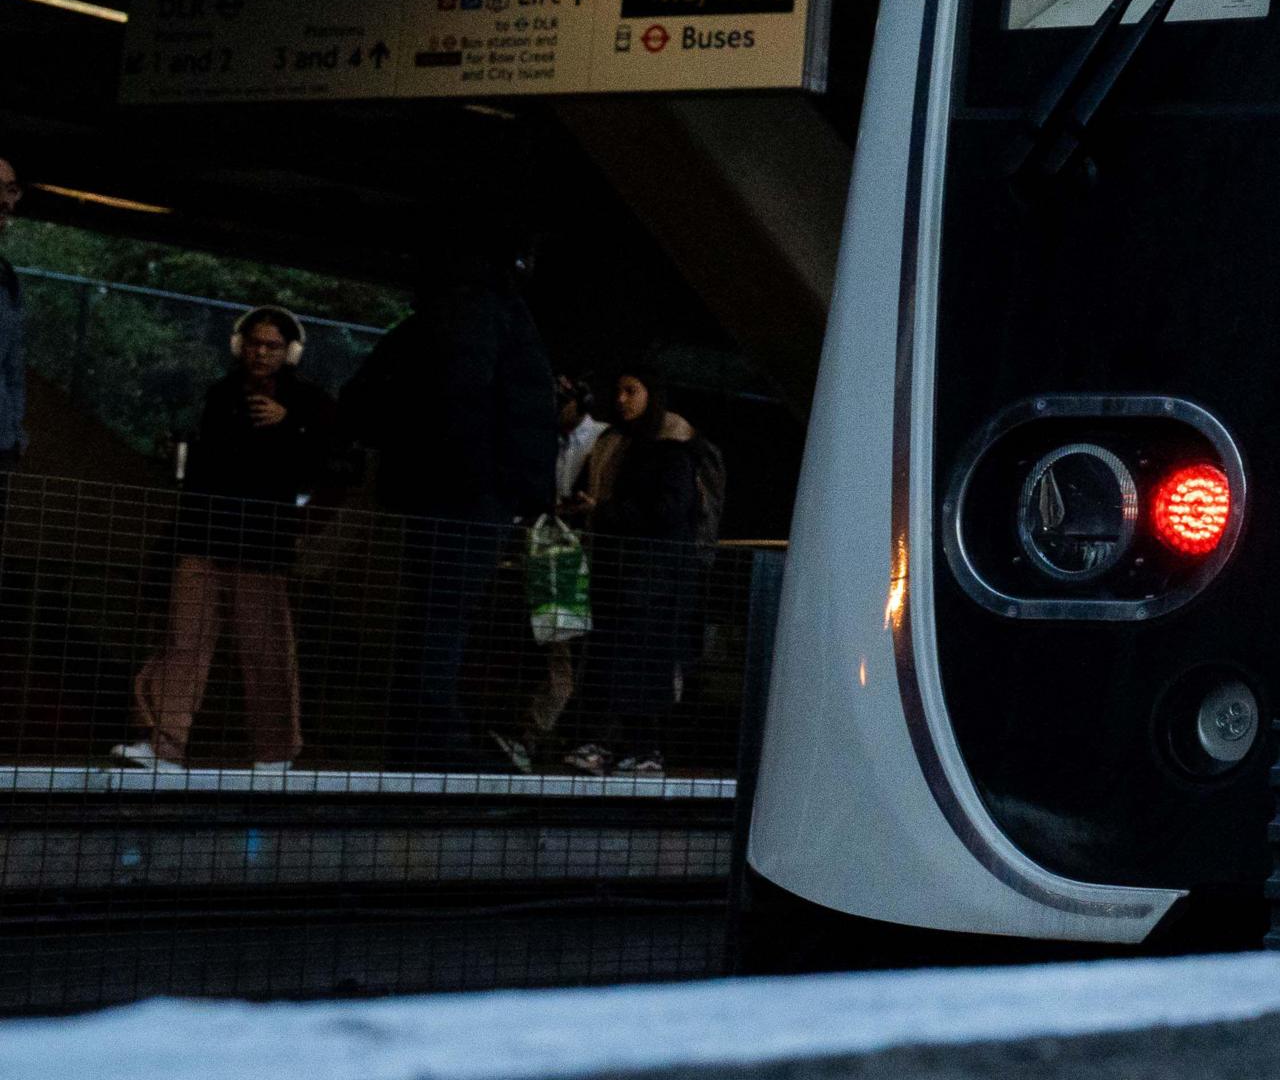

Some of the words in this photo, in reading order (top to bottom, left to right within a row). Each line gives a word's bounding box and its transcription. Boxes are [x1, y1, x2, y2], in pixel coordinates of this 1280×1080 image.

[682, 26, 756, 49] Buses
[274, 46, 287, 70] 3
[293, 45, 339, 71] and
